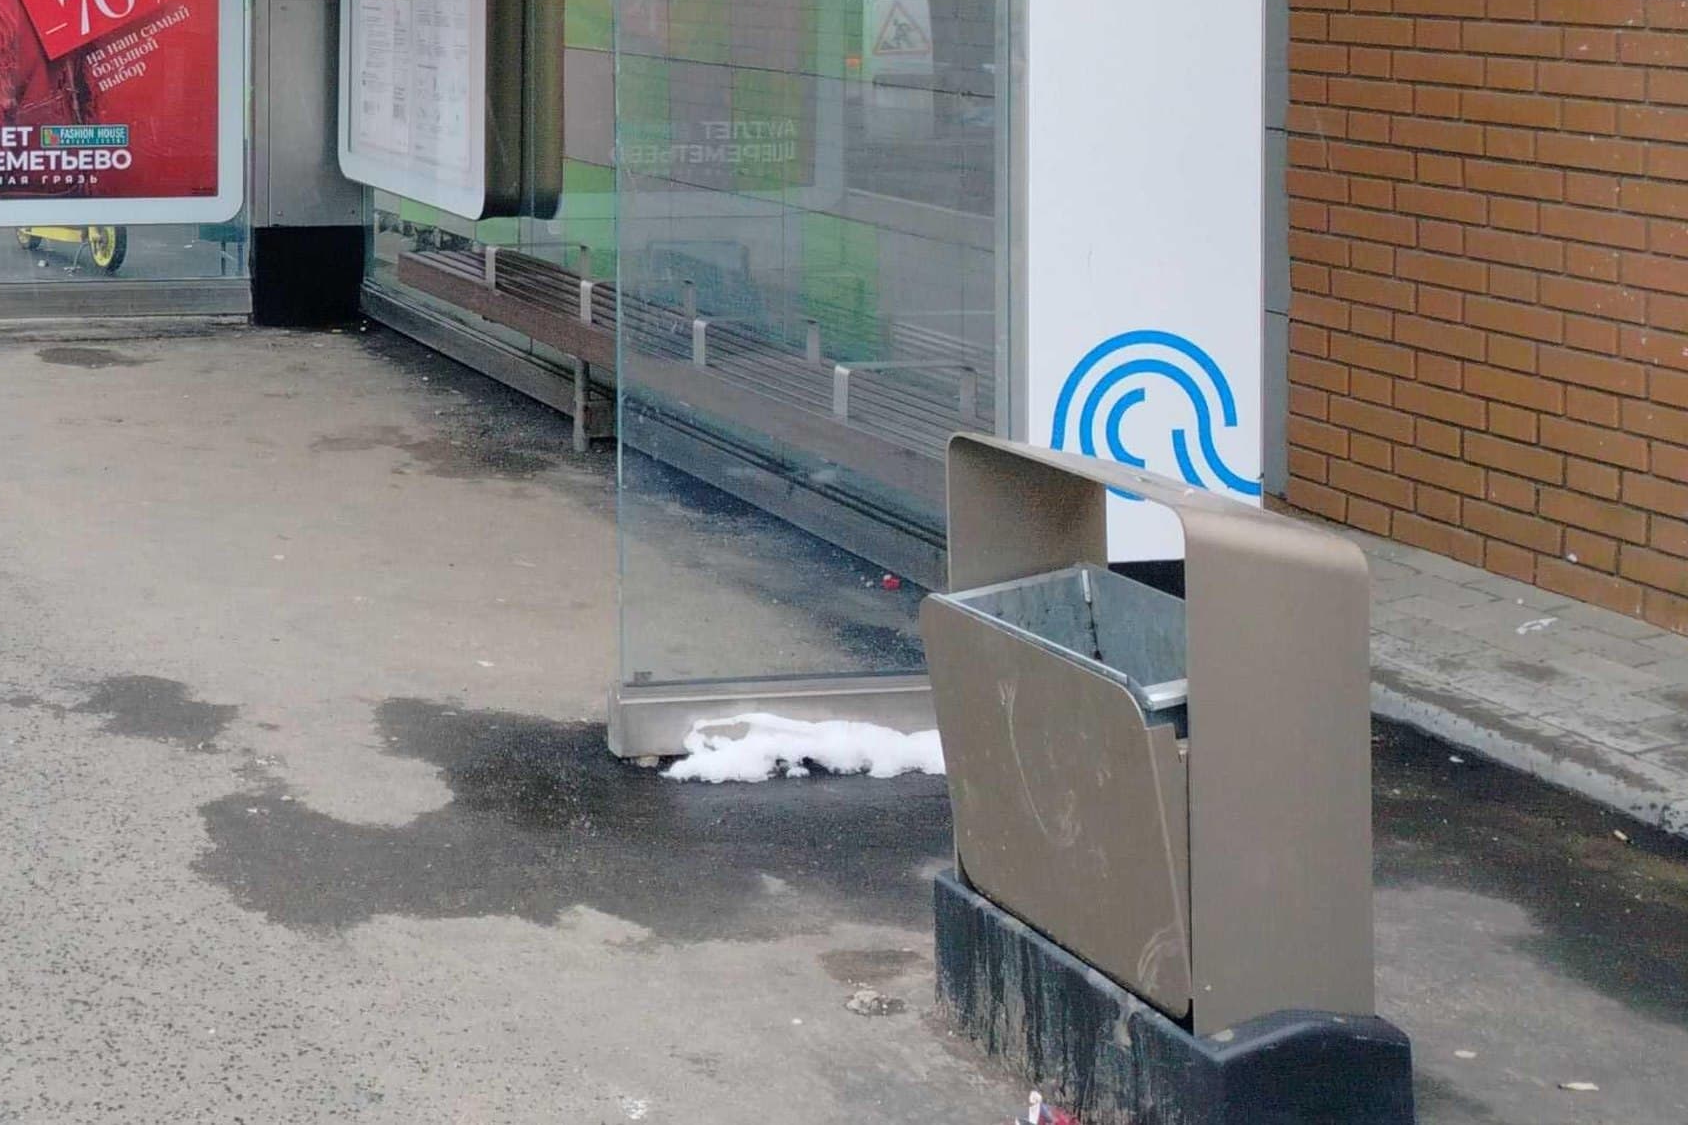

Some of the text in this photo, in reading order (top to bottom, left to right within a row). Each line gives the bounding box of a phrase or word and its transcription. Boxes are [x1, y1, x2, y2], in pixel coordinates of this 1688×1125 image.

[86, 5, 191, 66] на наш самый
[92, 38, 160, 79] большой
[98, 59, 147, 93] выбор
[60, 126, 126, 139] FASHION HOUSE
[41, 174, 99, 185] ГРЯЗЬ
